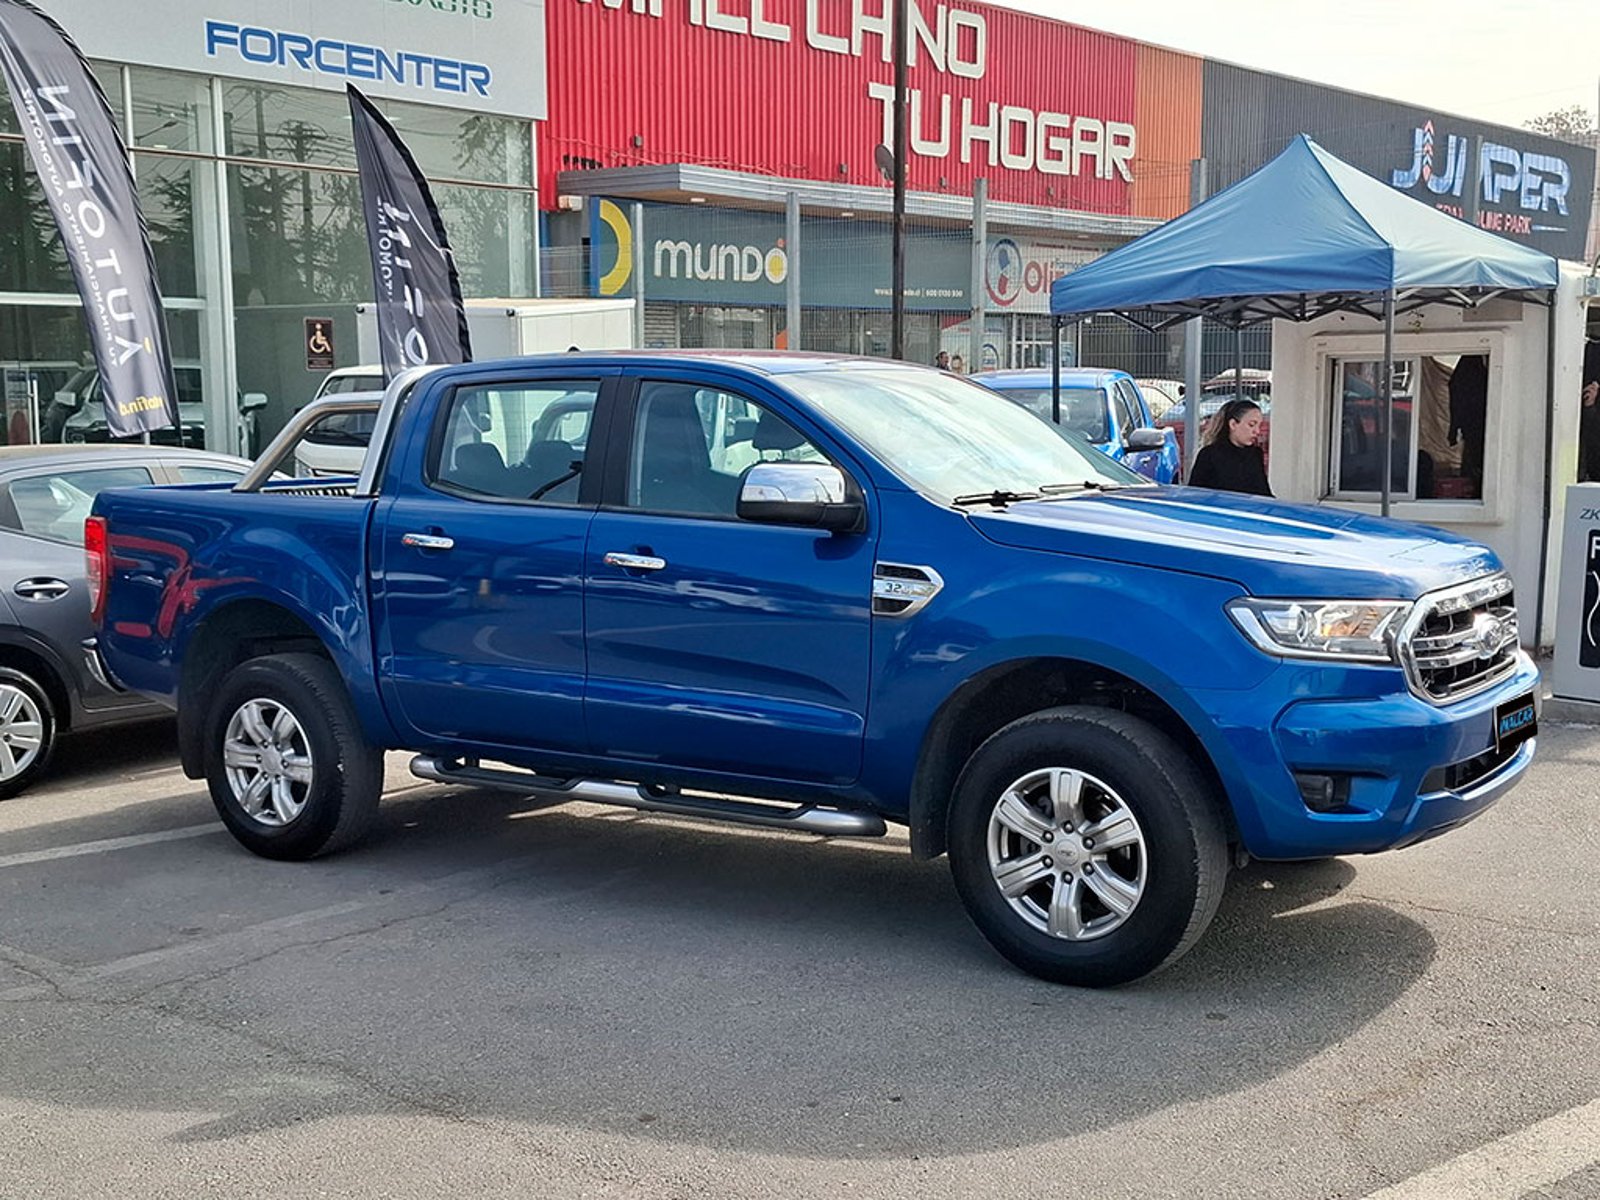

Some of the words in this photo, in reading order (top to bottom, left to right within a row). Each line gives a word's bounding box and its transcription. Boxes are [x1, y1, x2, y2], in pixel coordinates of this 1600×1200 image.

[205, 20, 492, 97] FORCENTER
[578, 0, 791, 43] LL
[806, 0, 986, 79] CHNO
[869, 82, 952, 158] TU
[961, 97, 1137, 183] HOGAR
[1504, 212, 1532, 235] PARK
[1024, 260, 1066, 295] Oli
